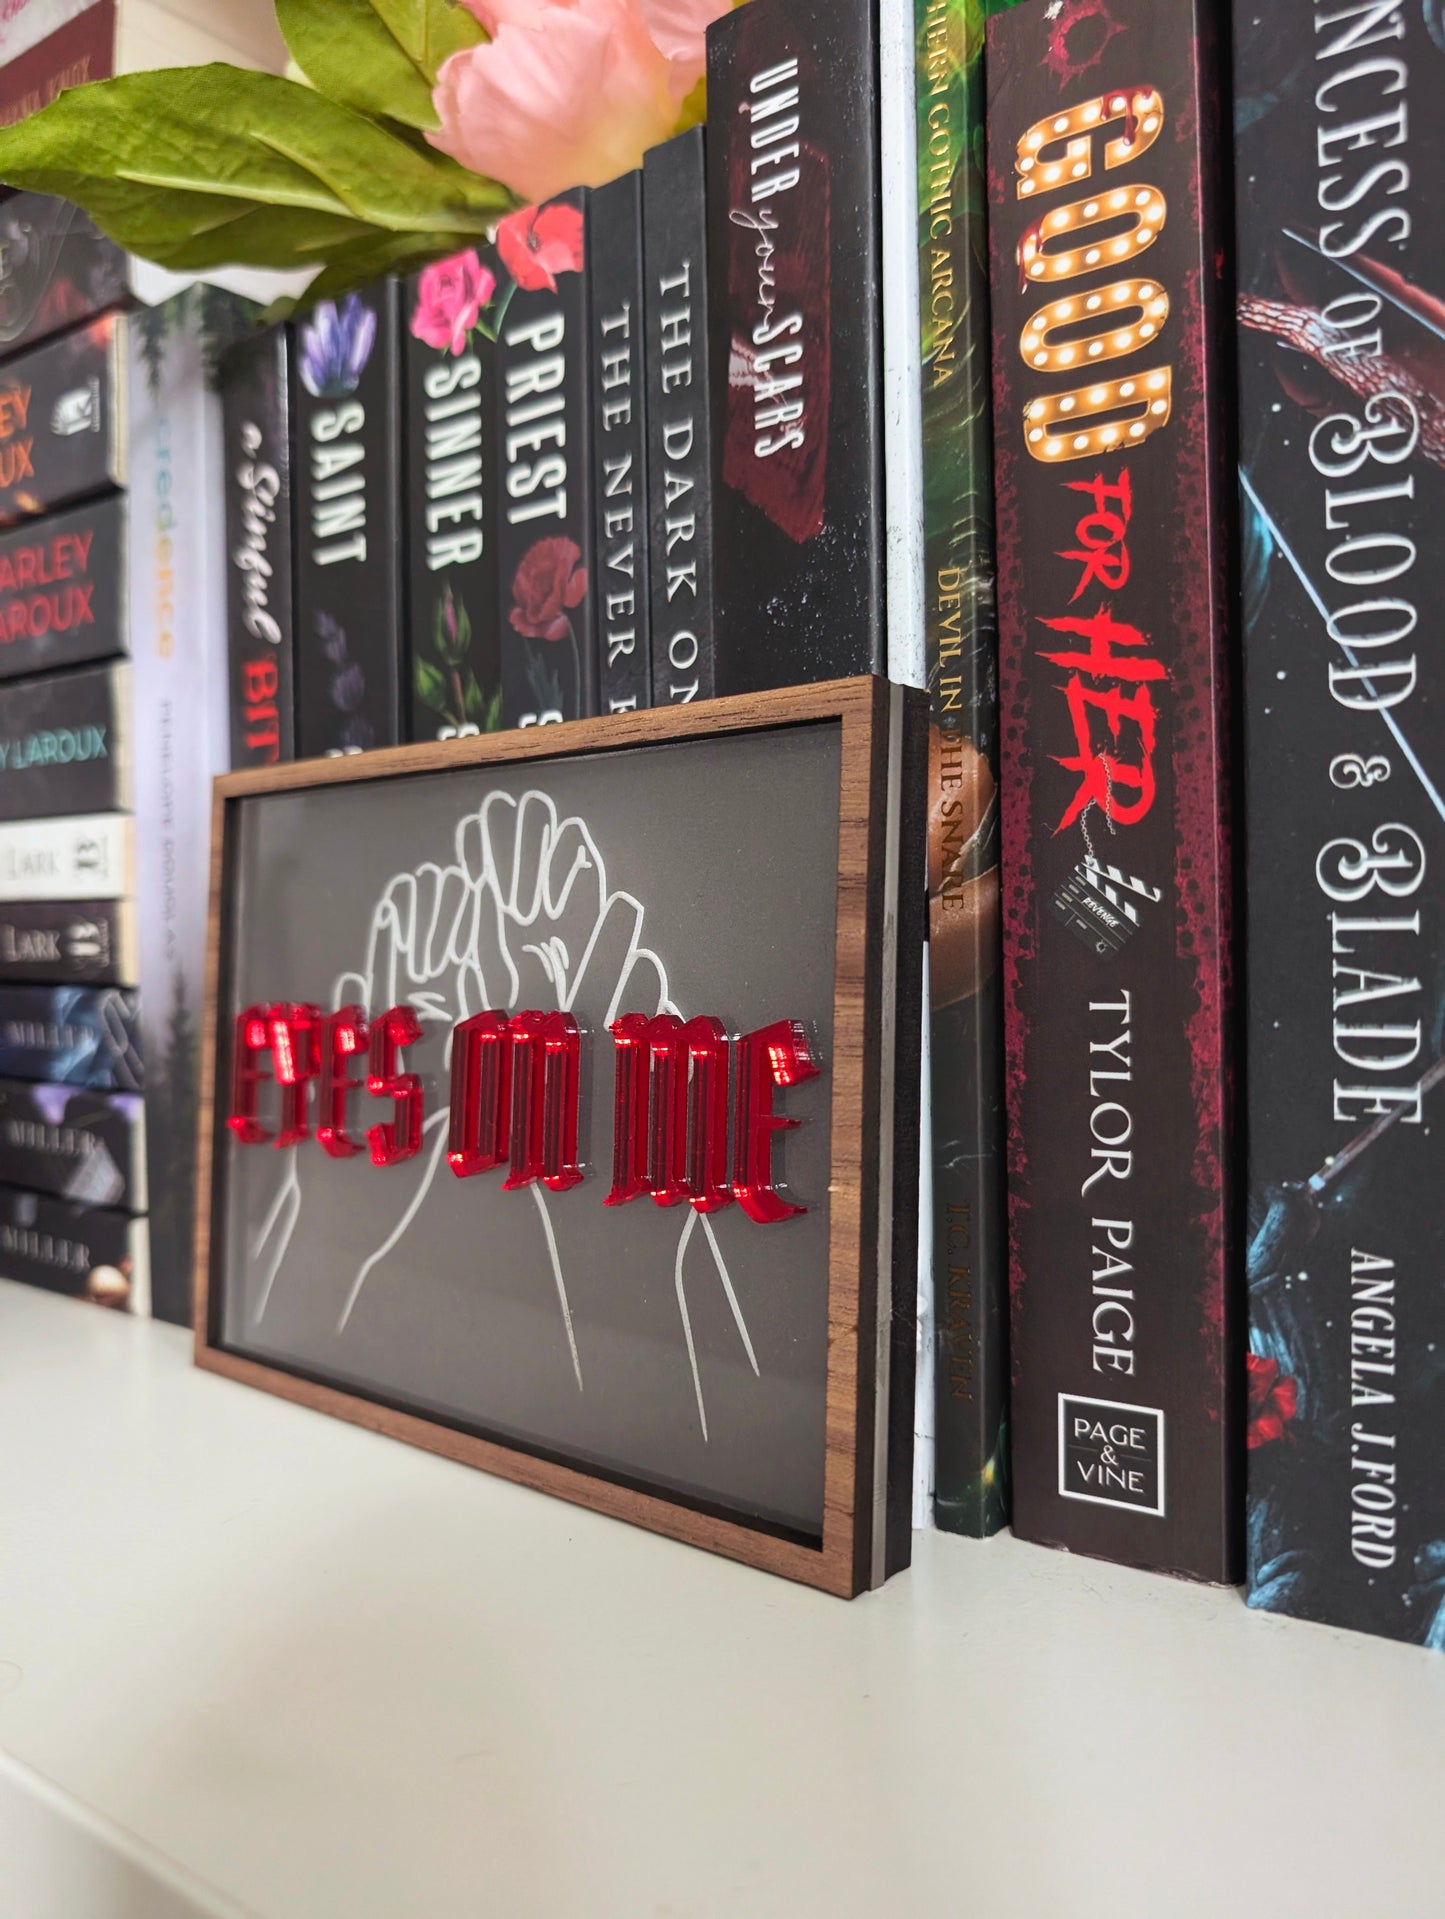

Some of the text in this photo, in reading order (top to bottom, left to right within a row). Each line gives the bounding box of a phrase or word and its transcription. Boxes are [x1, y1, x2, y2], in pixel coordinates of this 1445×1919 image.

[928, 103, 953, 240] GOTHIC
[1314, 0, 1411, 259] NCESS
[659, 258, 692, 394] THE
[729, 58, 805, 458] UNDER your SCARS
[930, 249, 956, 389] ARCANA
[1320, 293, 1383, 361] OF
[505, 312, 568, 525] PRIEST
[601, 300, 632, 432] THE
[310, 400, 367, 566] SAINT
[424, 355, 483, 571] SINNER
[663, 416, 697, 603] DARK
[1015, 85, 1172, 838] GOOD FOR HER
[233, 459, 282, 645] Sinful
[603, 453, 637, 669] NEVER
[1309, 391, 1419, 710] BLOOD
[12, 722, 109, 771] LAROUX
[937, 567, 965, 911] DEVIL IN THE SNARE
[2, 922, 62, 963] LARK
[1316, 822, 1426, 1124] BLADE
[1081, 989, 1136, 1377] TYLOR PAIGE
[948, 1264, 973, 1403] KRAVEN
[1350, 1247, 1397, 1408] ANGELA
[1074, 1417, 1146, 1451] PAGE
[1077, 1460, 1145, 1494] VINE
[1100, 1444, 1119, 1466] &
